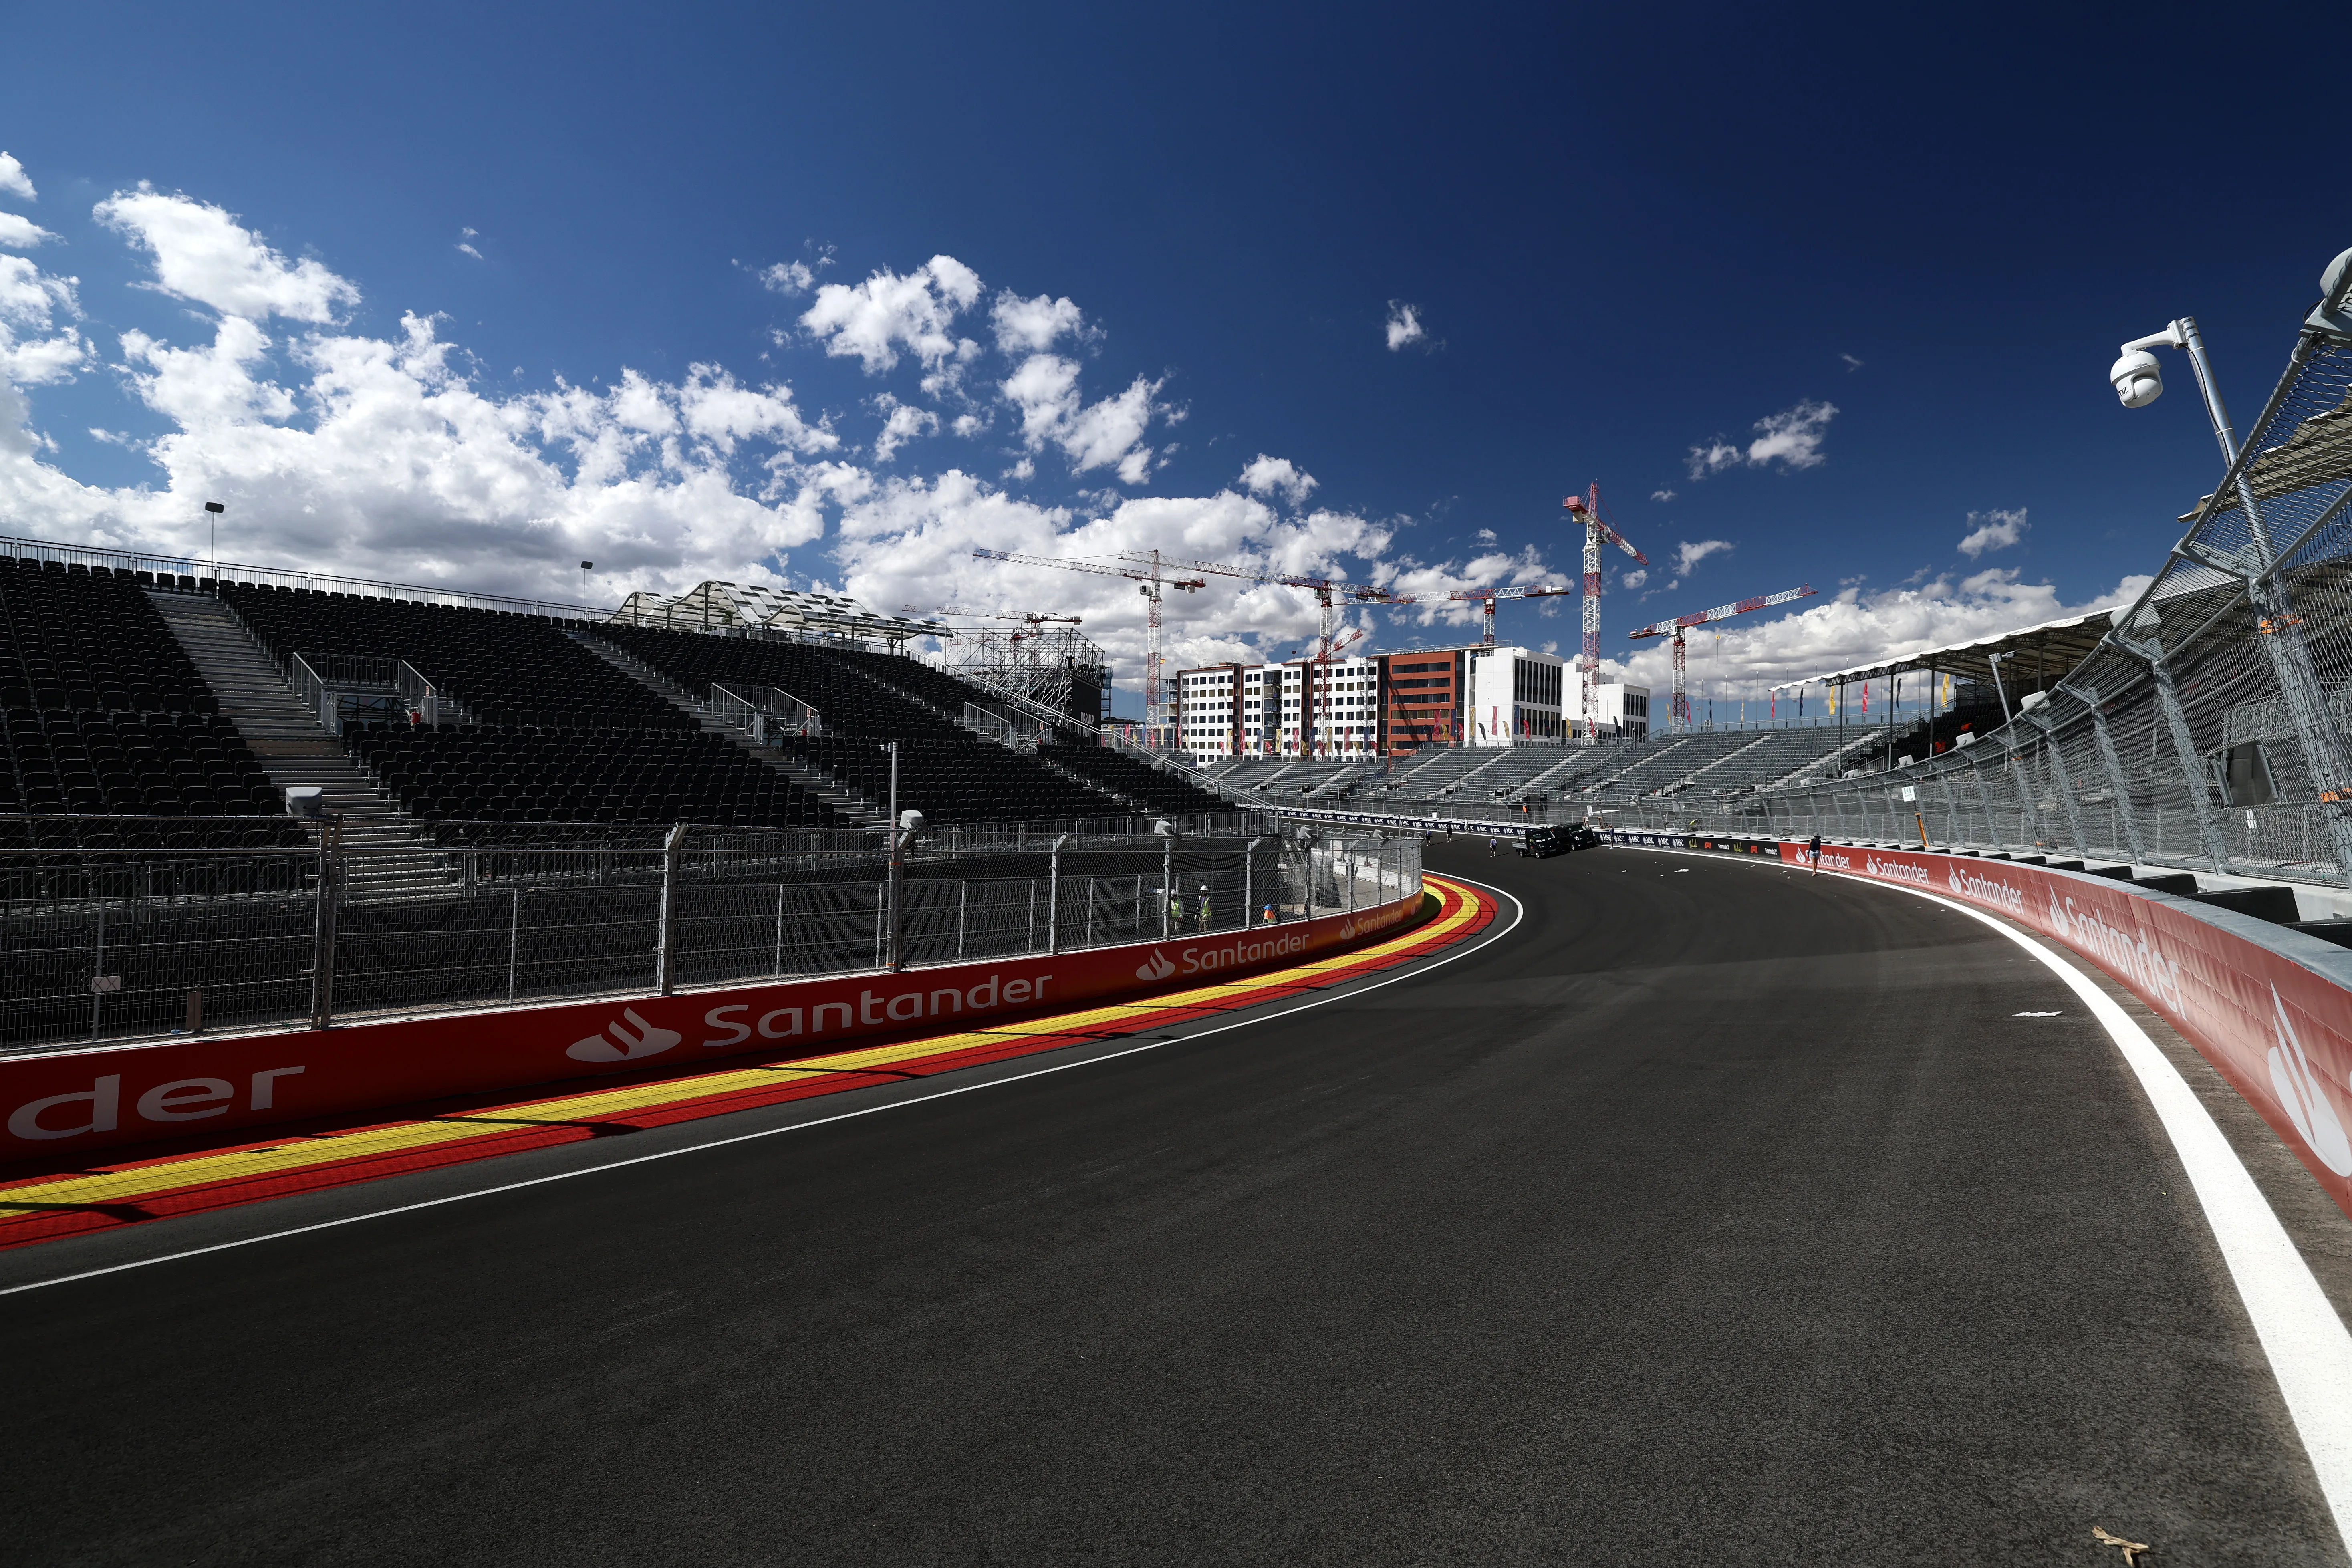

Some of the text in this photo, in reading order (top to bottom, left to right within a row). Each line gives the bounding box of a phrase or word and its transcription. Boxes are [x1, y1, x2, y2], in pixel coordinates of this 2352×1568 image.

[1081, 712, 1094, 725] WARM UP
[1805, 850, 1850, 869] Sntander
[1876, 857, 1929, 884] Santander
[1960, 869, 2024, 915] Santander
[1357, 909, 1402, 936] Santander
[1182, 933, 1309, 974] Santander
[2065, 897, 2187, 1021] Santander
[703, 975, 1053, 1047] Santander
[8, 1066, 306, 1140] der
